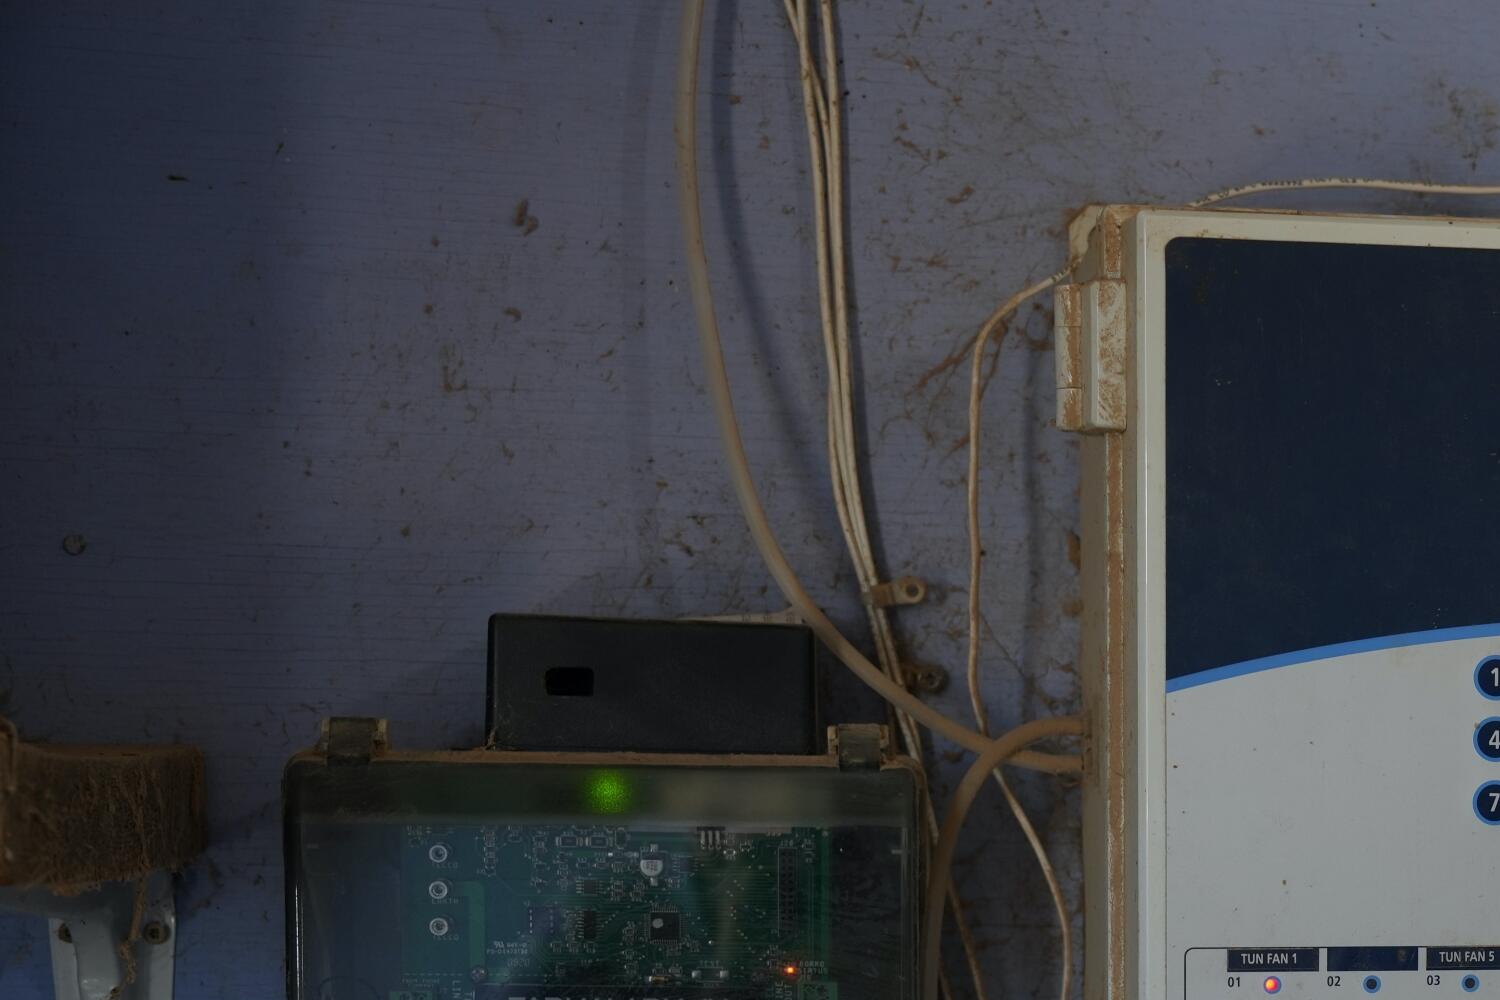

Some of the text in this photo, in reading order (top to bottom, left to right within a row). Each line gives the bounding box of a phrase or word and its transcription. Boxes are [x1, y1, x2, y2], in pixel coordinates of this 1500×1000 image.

[1489, 667, 1500, 687] 1
[1488, 793, 1500, 813] 7
[1240, 952, 1298, 965] TUN FAN 1
[1439, 951, 1495, 963] TUN FAN 5
[1227, 974, 1241, 987] 01
[1327, 973, 1341, 987] 02
[1426, 973, 1441, 986] 03
